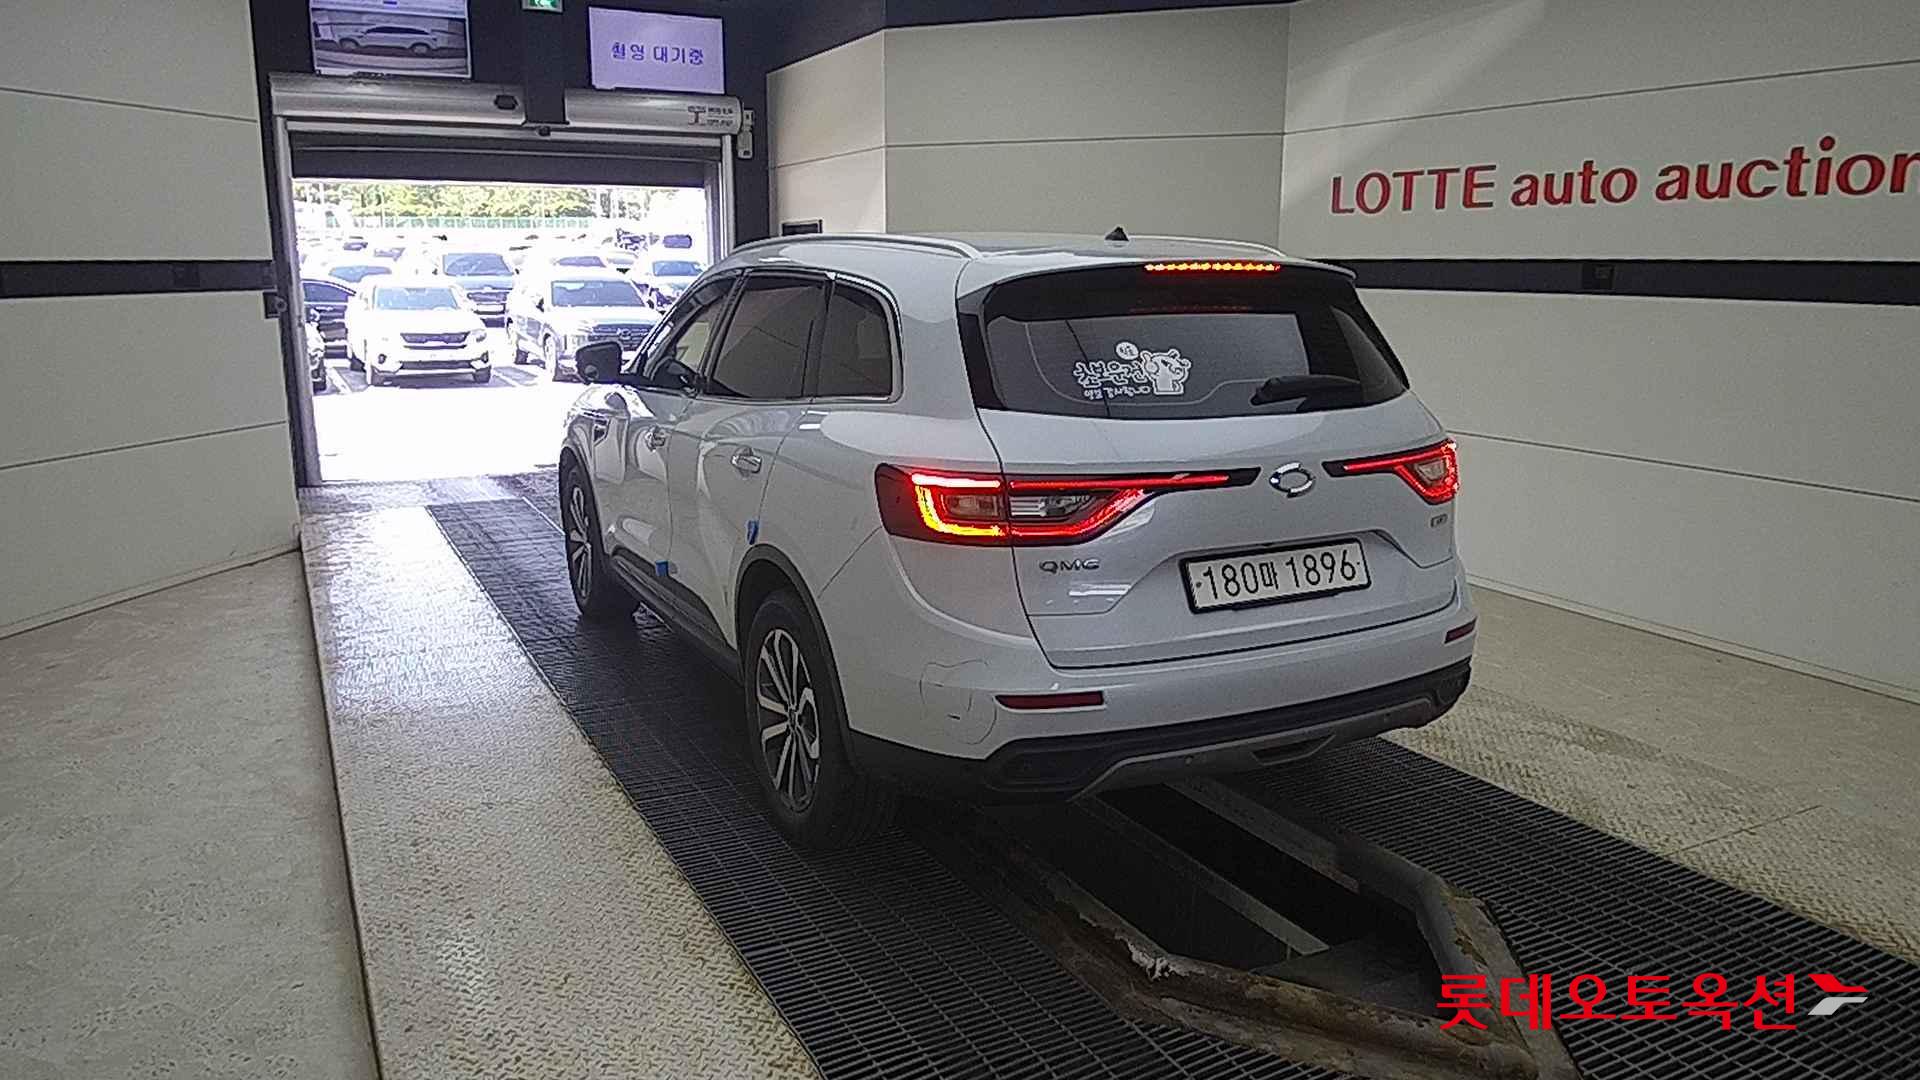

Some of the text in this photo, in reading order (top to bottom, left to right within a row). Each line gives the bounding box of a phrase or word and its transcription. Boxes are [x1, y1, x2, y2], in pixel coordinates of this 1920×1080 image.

[1331, 164, 1496, 214] LOTTE
[1511, 160, 1637, 207] auto
[1203, 549, 1357, 600] 180마 1896
